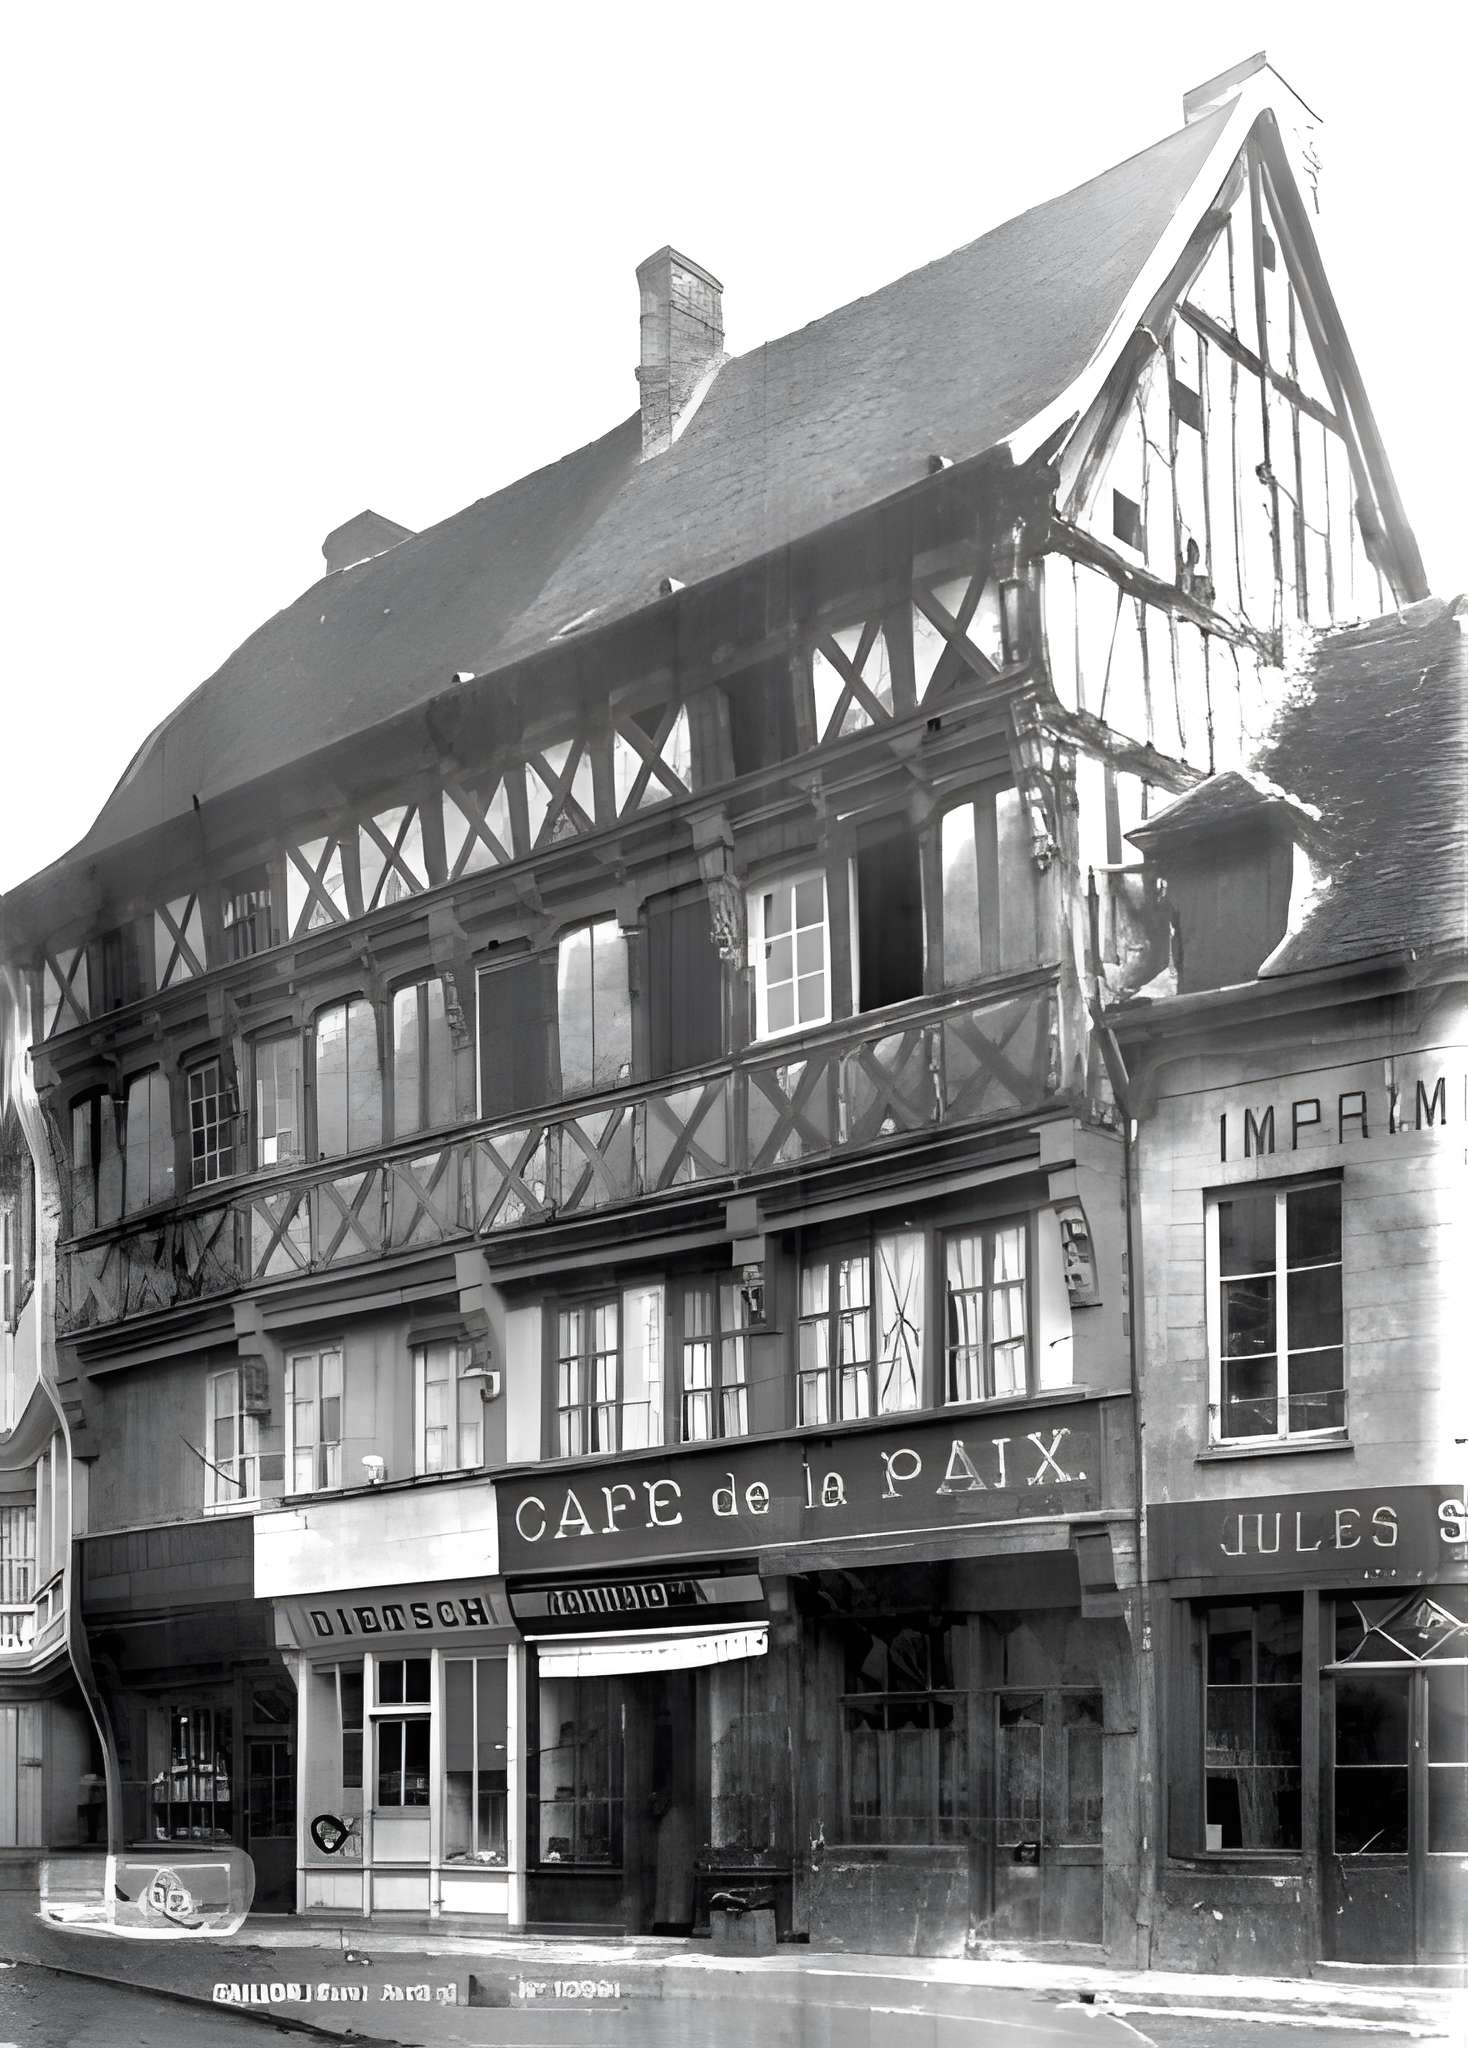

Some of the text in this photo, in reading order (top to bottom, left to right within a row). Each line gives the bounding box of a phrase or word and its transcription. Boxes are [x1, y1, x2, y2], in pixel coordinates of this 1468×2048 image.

[712, 1472, 769, 1516] de
[803, 1462, 847, 1508] la
[1220, 1506, 1398, 1555] JULES
